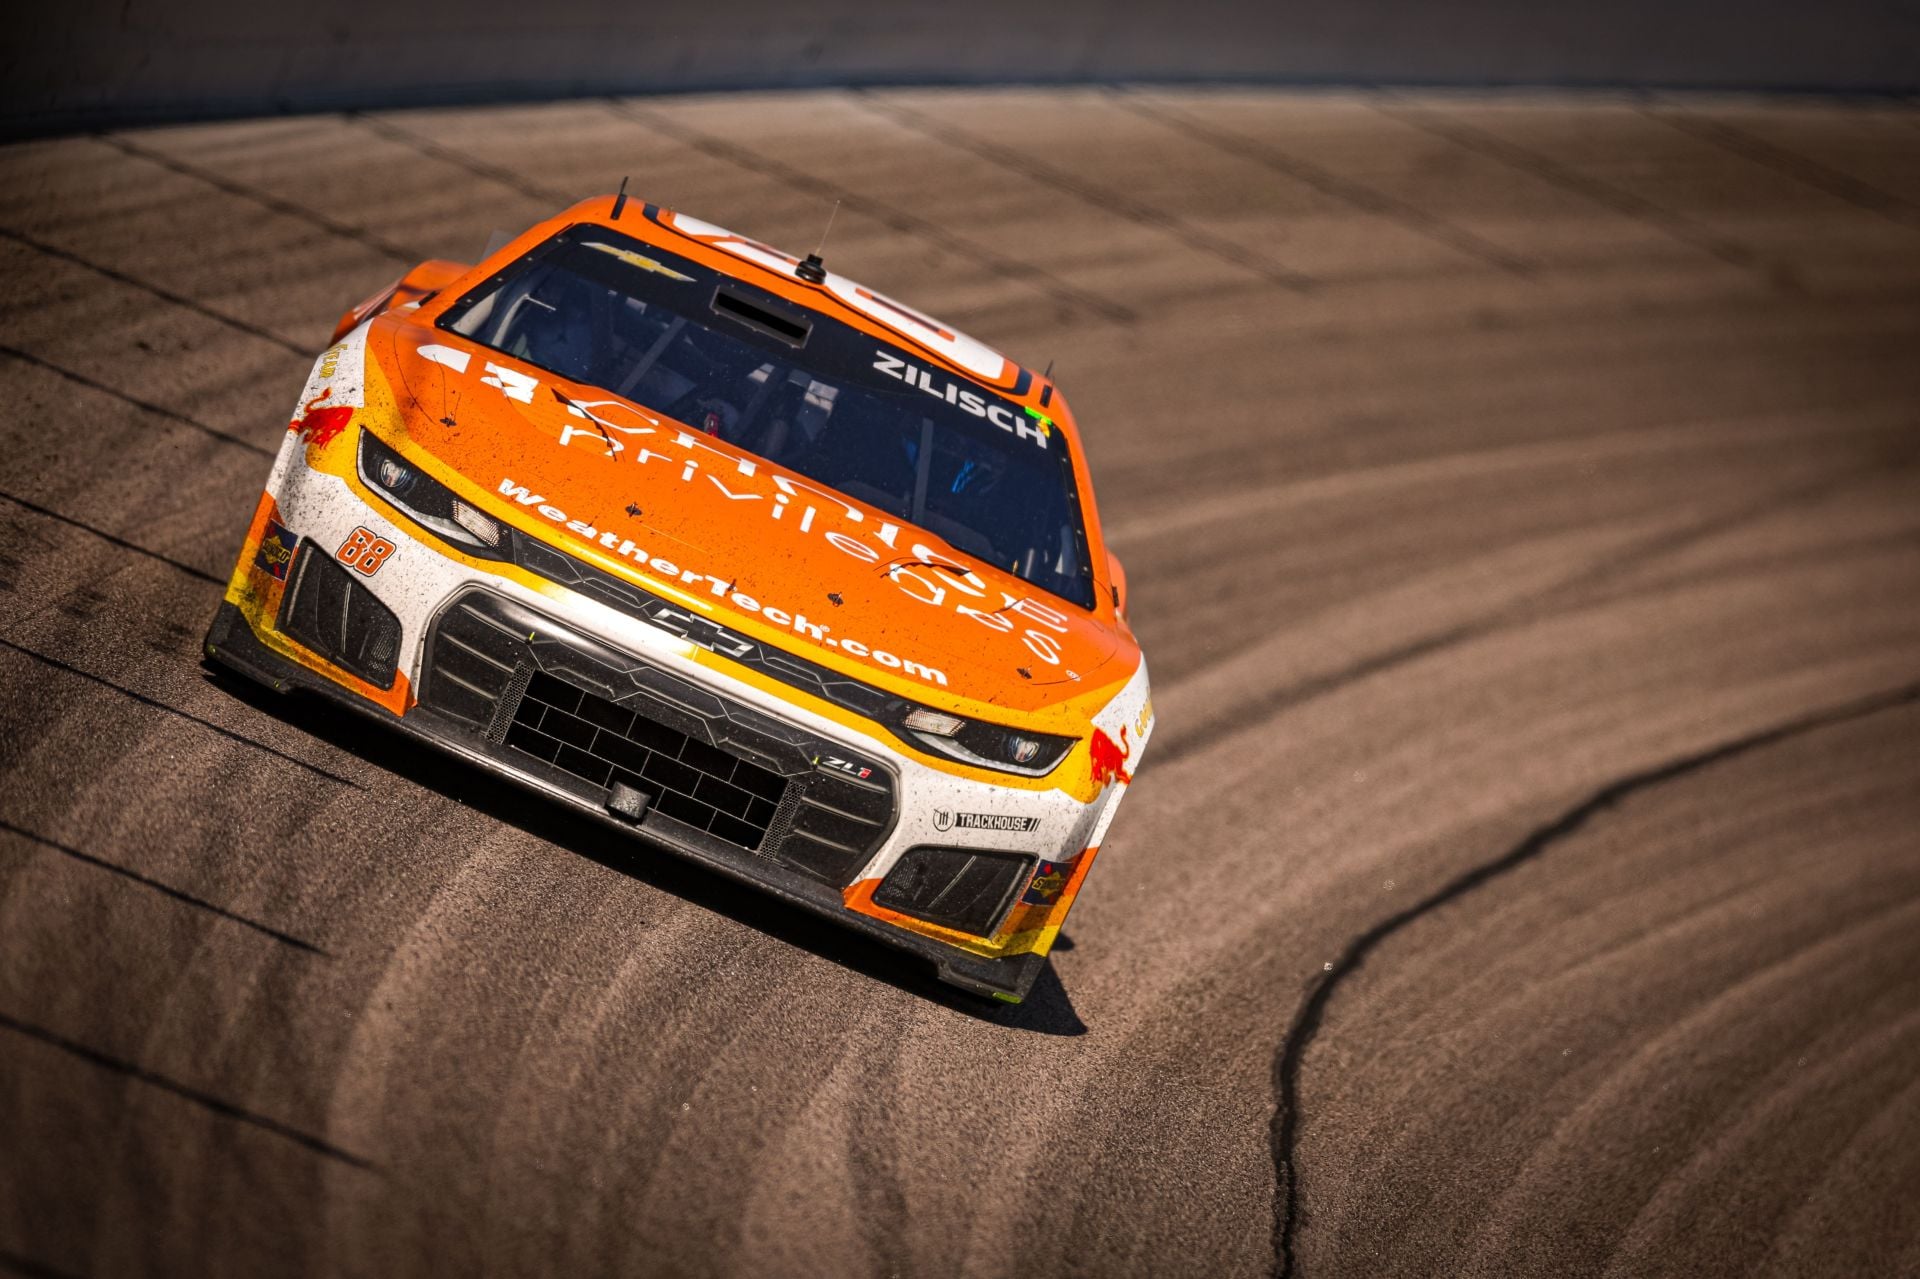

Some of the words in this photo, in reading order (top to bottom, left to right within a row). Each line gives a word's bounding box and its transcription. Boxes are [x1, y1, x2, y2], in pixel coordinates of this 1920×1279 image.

[872, 349, 1048, 450] ZILISCH
[335, 525, 397, 578] 88
[959, 813, 1028, 831] TRACKHOUSE
